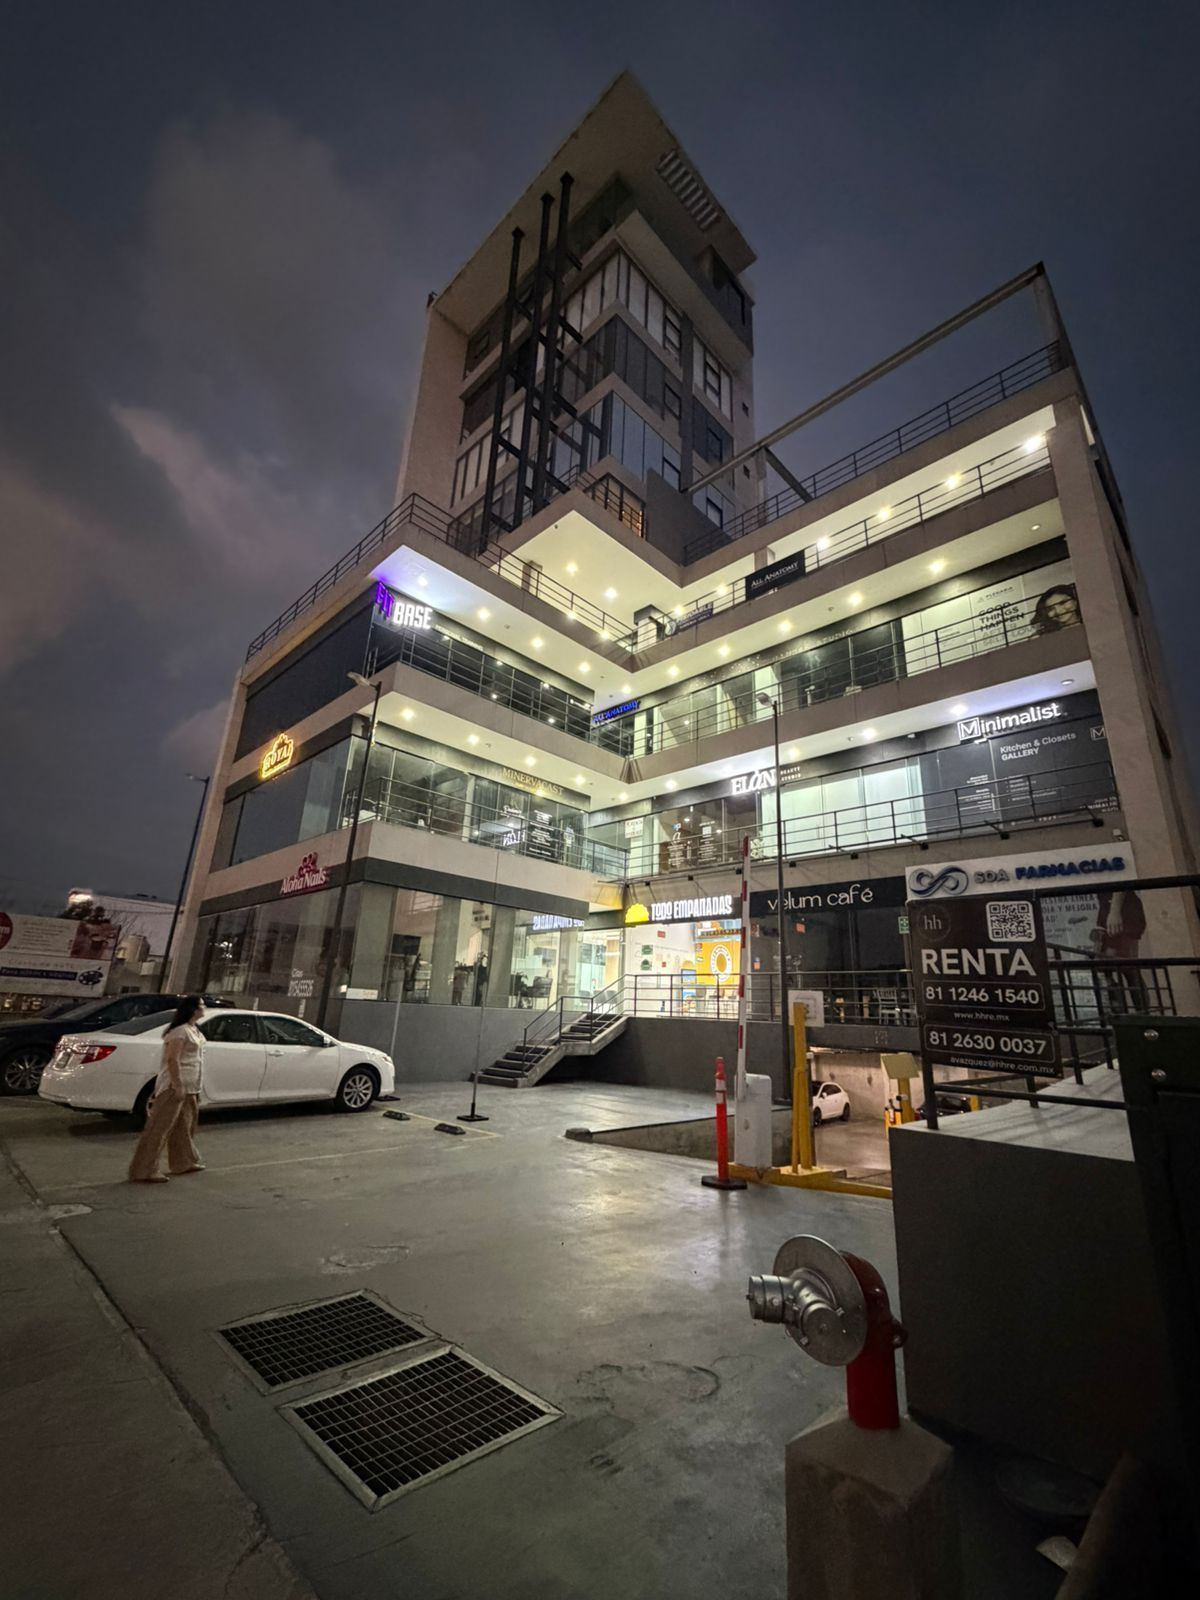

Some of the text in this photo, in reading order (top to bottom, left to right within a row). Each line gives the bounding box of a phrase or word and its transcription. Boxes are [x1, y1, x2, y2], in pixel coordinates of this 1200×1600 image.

[751, 561, 798, 588] ALL ANATOMY
[375, 581, 433, 629] FIT BASE
[958, 702, 1061, 741] Minimalist
[1000, 732, 1077, 755] Kitchen & Closets
[1001, 747, 1040, 761] GALLERY
[304, 867, 326, 888] Nails
[1015, 857, 1125, 880] FARMACIAS
[674, 894, 733, 919] EMPANADAS
[827, 884, 874, 906] café
[921, 948, 1037, 976] RENTA
[926, 986, 1039, 1004] 81 1246 1540
[954, 1012, 1010, 1021] www.hhre.mx
[929, 1031, 1046, 1055] 81 2630 0037
